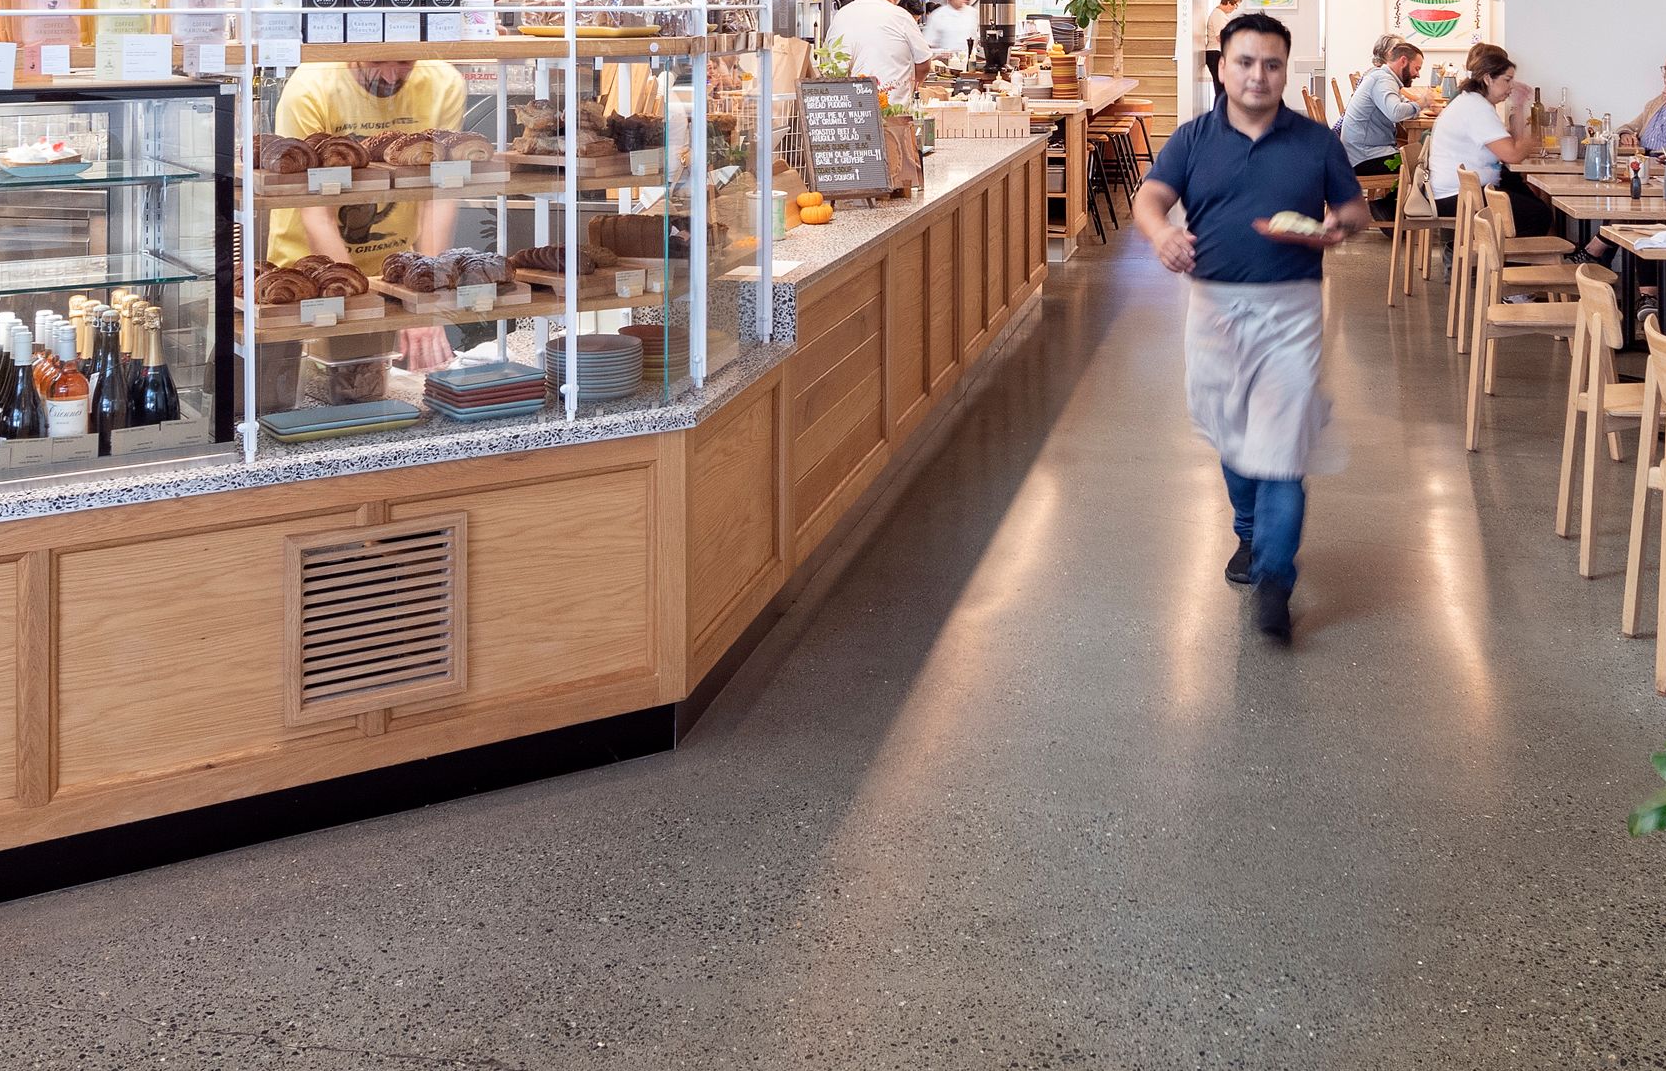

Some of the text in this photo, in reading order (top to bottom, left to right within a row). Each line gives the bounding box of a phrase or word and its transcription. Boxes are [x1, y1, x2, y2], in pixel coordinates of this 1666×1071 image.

[848, 110, 872, 119] WALNUT
[360, 121, 391, 130] MUSIC
[839, 133, 860, 141] SALAD
[815, 151, 833, 159] GREEN
[818, 172, 855, 182] MISO SQUASH
